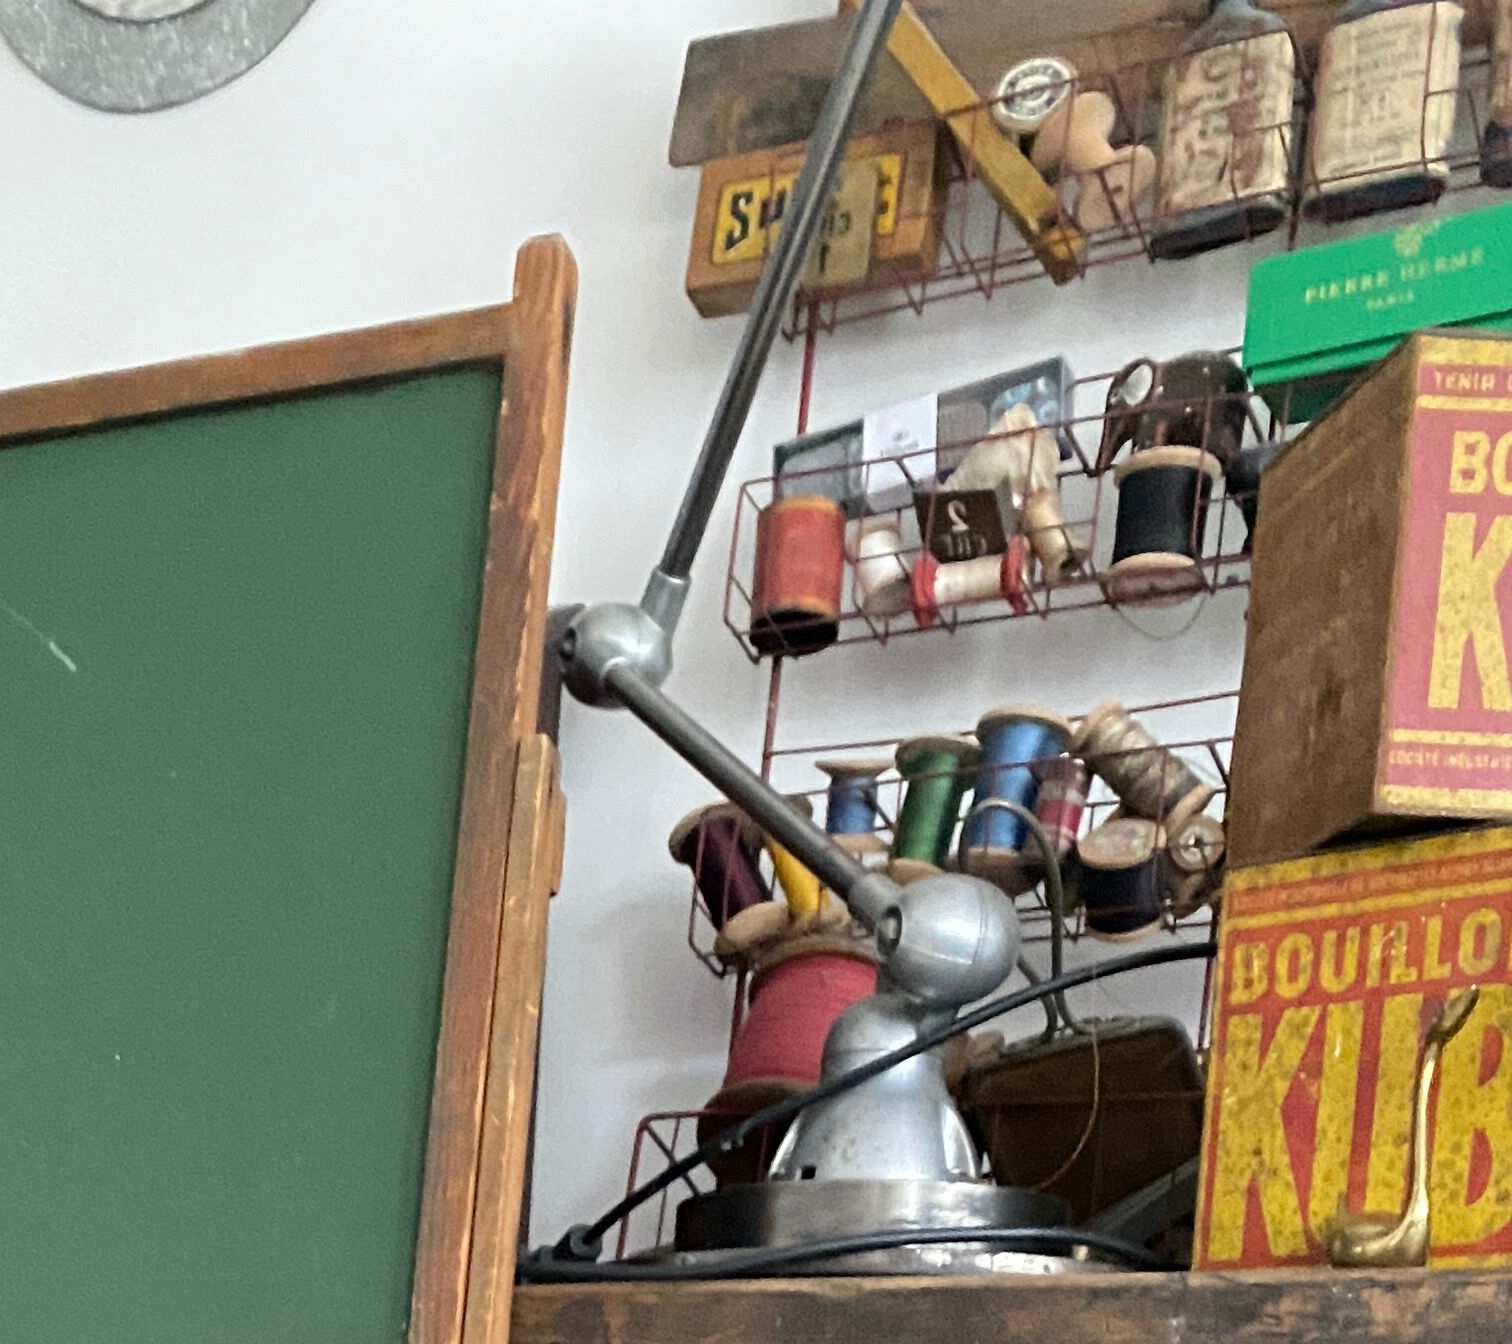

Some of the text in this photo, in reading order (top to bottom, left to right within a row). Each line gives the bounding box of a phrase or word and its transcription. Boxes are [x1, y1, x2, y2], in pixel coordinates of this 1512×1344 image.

[1305, 271, 1387, 304] PIERRE
[1434, 370, 1494, 391] TENIR
[1229, 907, 1512, 1004] BOUILLO
